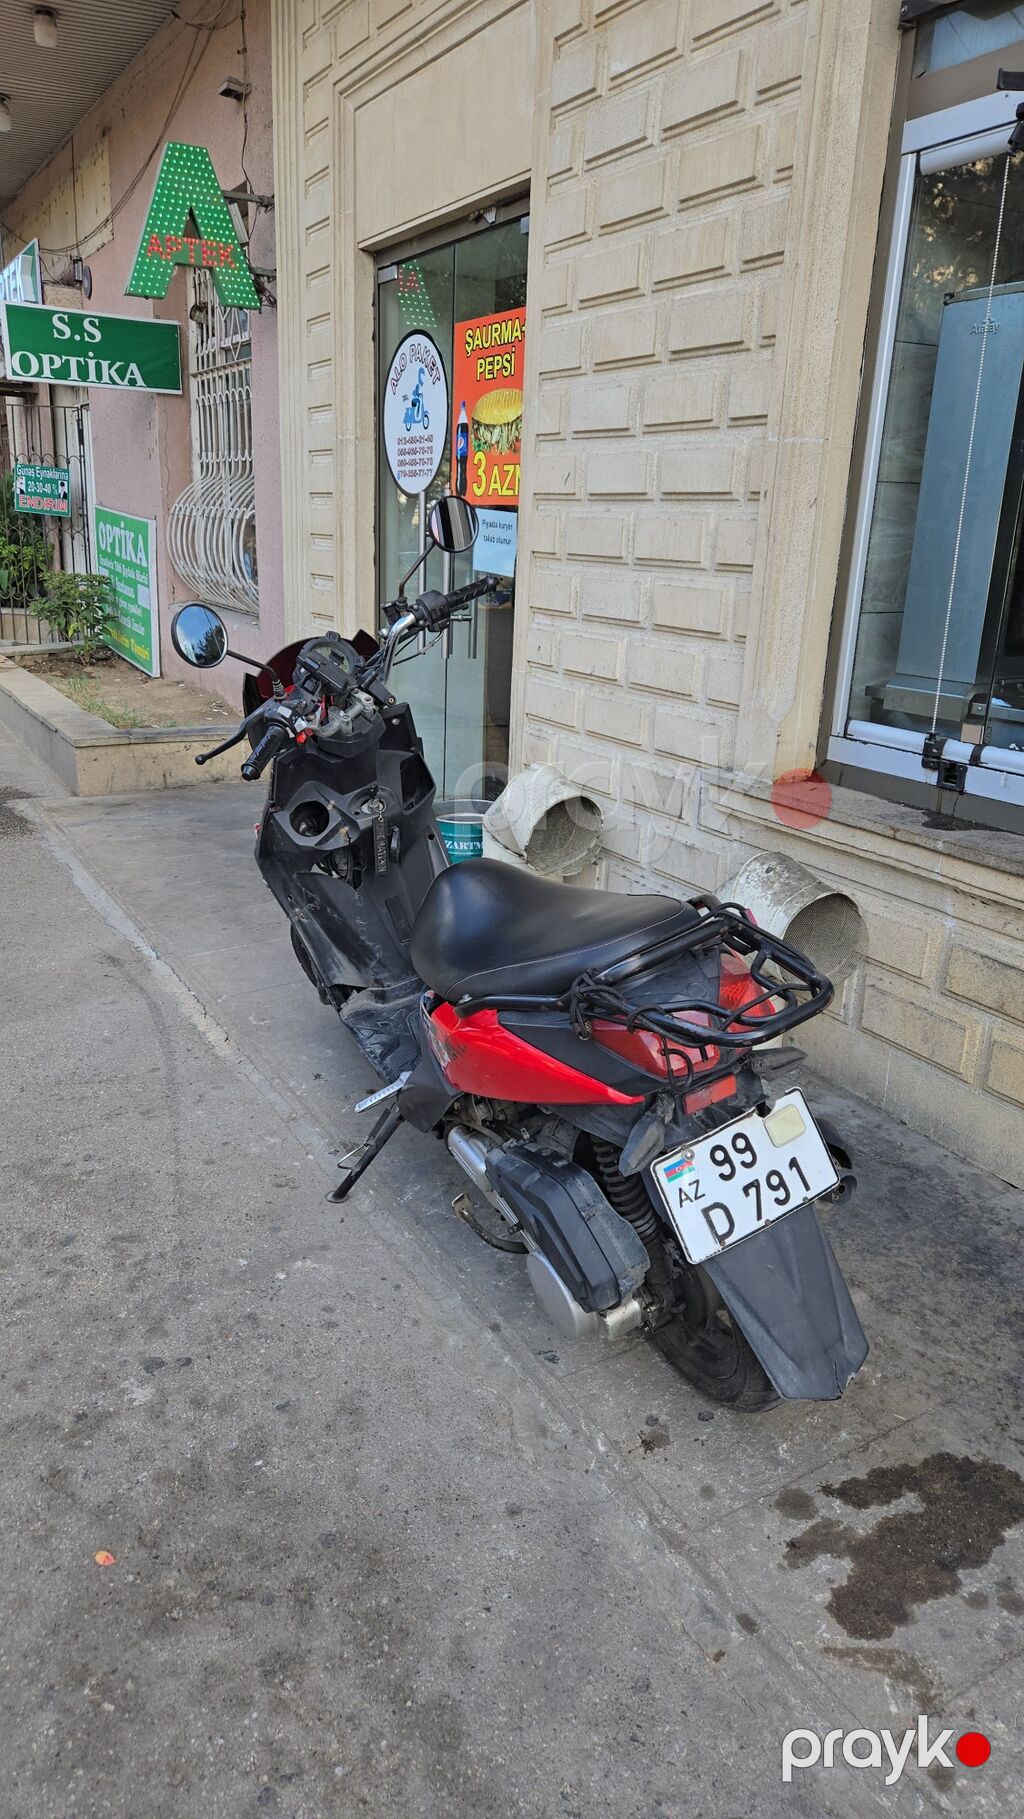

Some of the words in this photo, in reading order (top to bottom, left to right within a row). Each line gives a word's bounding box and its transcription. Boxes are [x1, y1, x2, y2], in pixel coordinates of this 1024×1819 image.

[147, 234, 237, 268] APTEK
[52, 313, 102, 343] S.S
[11, 351, 147, 387] OPTİKA
[390, 353, 407, 395] ALO
[409, 343, 441, 385] PAKET
[476, 346, 515, 381] PEPSİ
[472, 450, 487, 497] 3
[98, 521, 148, 567] OPTİKA
[709, 1132, 757, 1182] 99
[677, 1179, 706, 1208] AZ
[701, 1202, 735, 1245] D
[742, 1157, 811, 1221] 791
